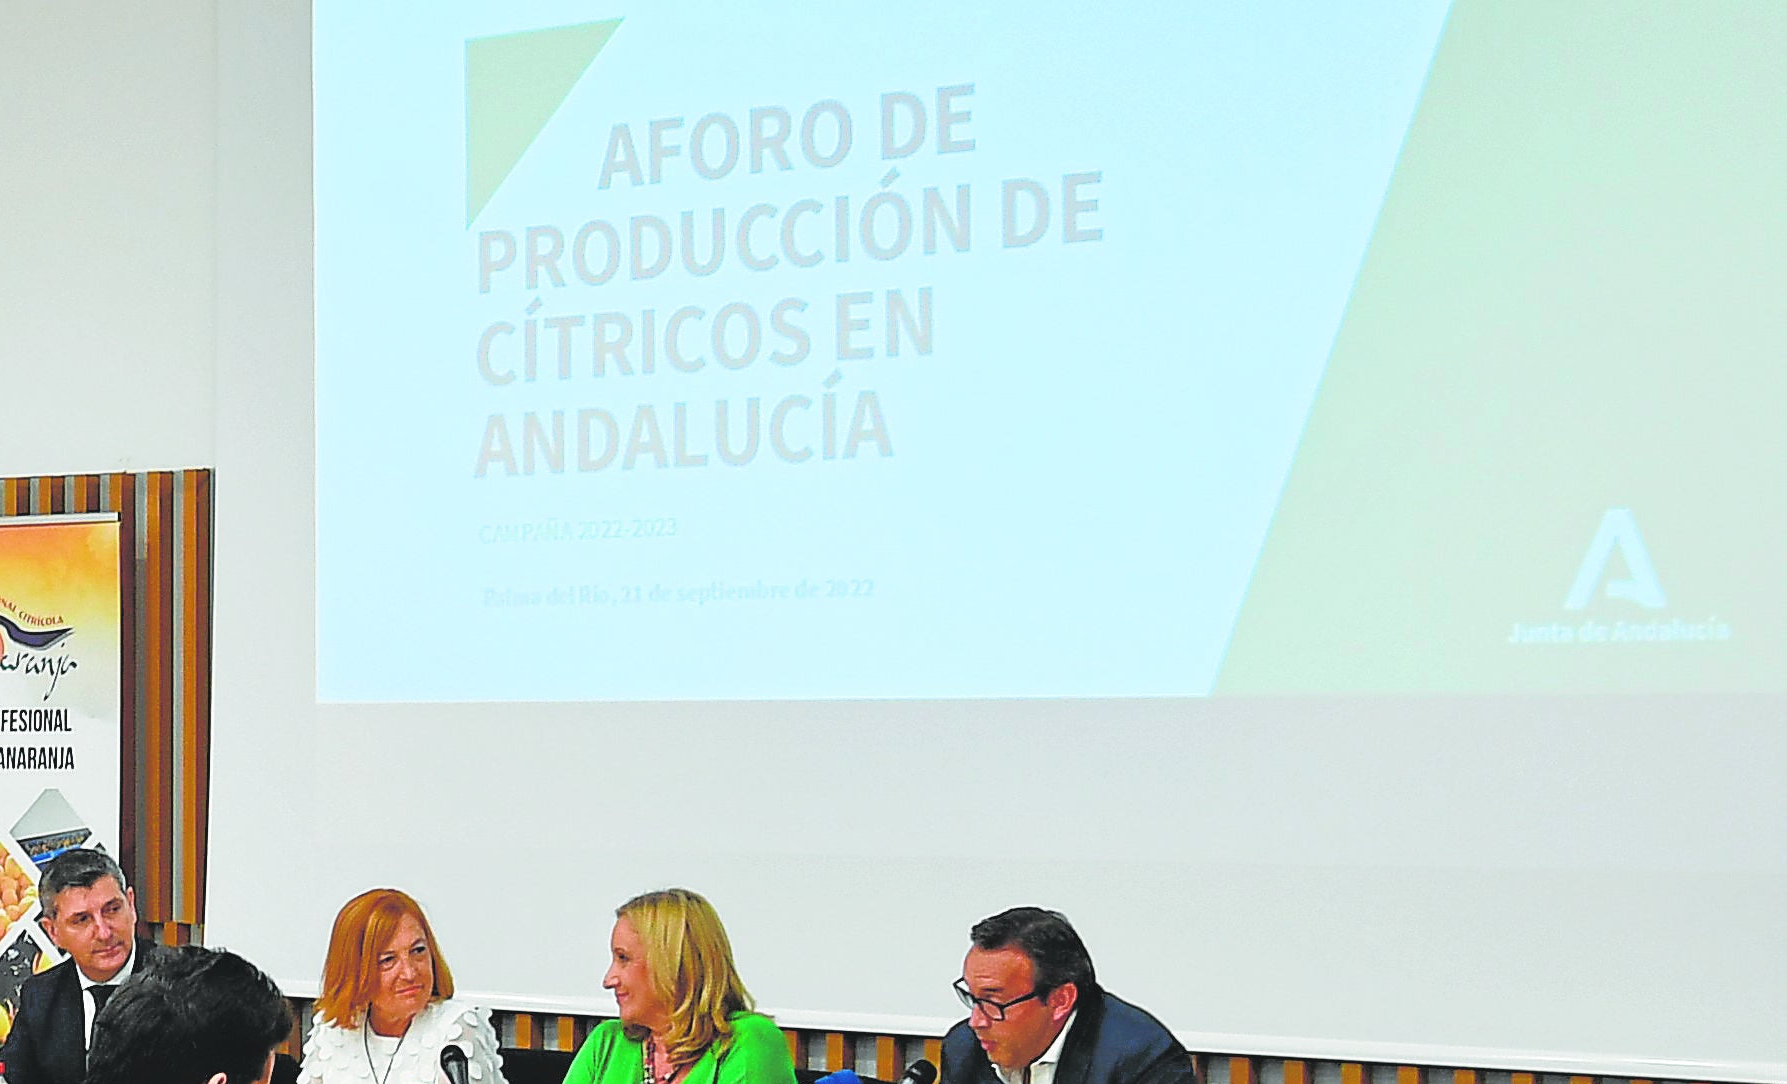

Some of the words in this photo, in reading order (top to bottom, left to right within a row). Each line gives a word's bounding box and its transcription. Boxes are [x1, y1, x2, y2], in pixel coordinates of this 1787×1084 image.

[598, 100, 853, 189] AFORO
[880, 83, 976, 160] DE
[477, 168, 972, 293] PRODUCCIÓN
[1001, 170, 1104, 249] DE
[476, 298, 812, 386] CÍTRICOS
[835, 286, 935, 361] EN
[474, 371, 895, 479] ANDALUCÍA
[478, 517, 573, 544] CAMPAÑA
[647, 583, 673, 604] de
[676, 579, 790, 606] septiembre
[793, 578, 820, 599] de
[1508, 621, 1574, 644] Junta
[1580, 620, 1608, 642] de
[1611, 614, 1733, 642] Andalucía
